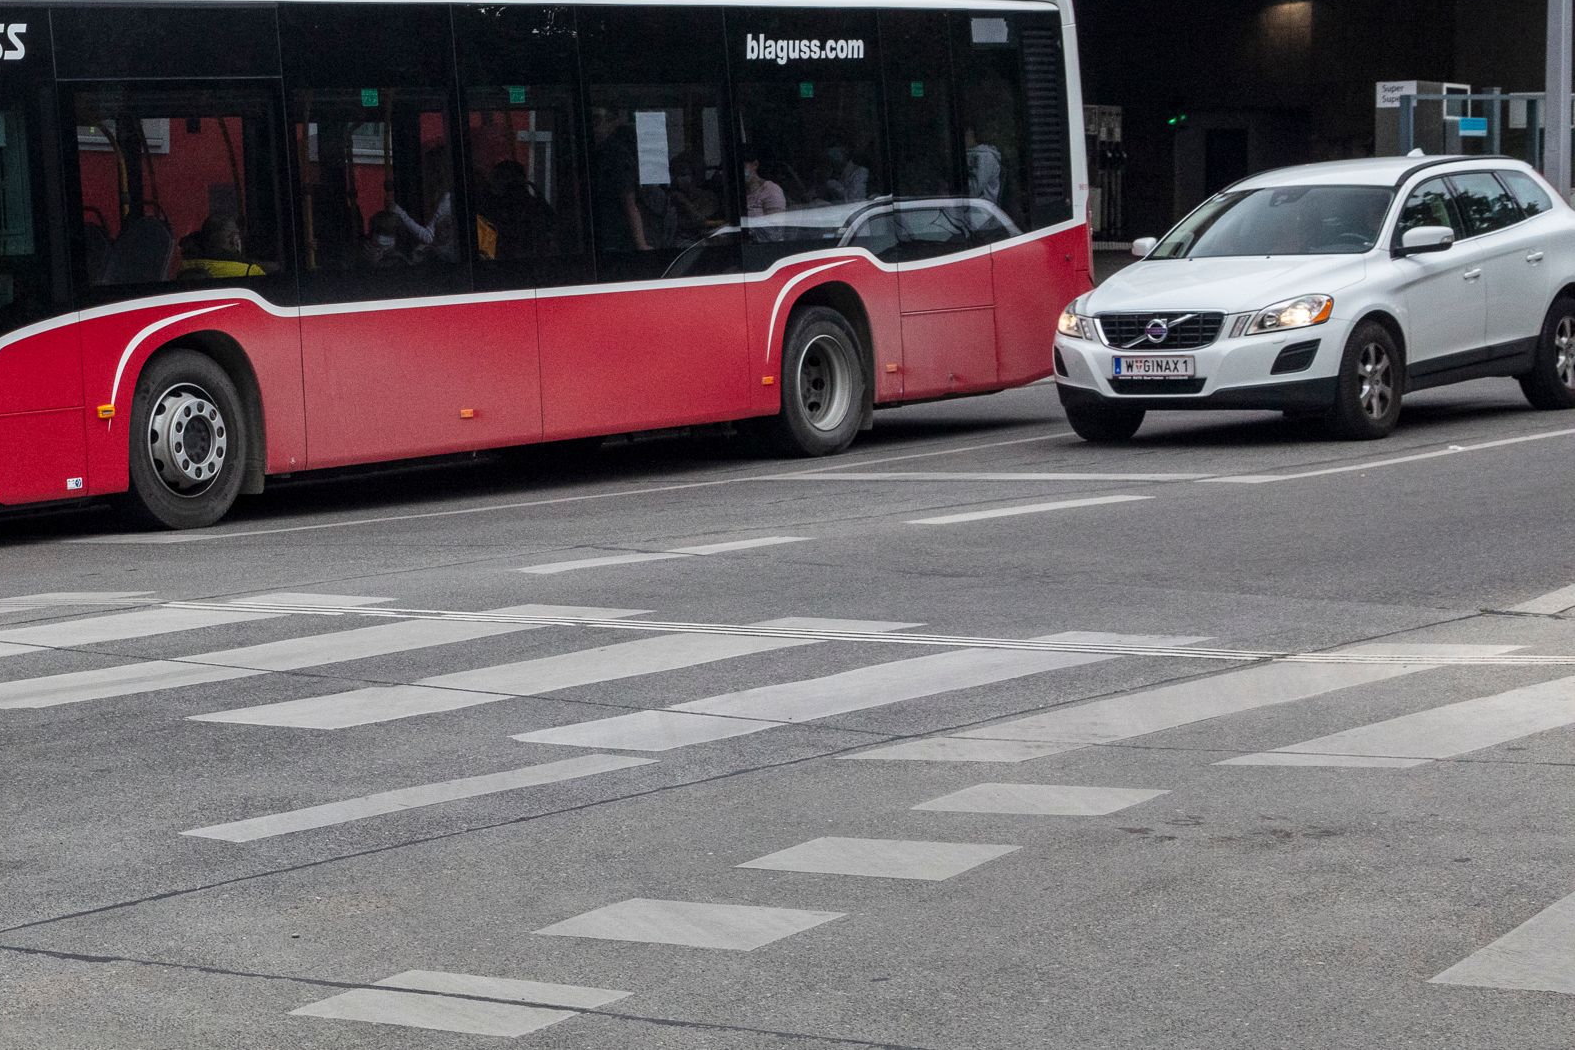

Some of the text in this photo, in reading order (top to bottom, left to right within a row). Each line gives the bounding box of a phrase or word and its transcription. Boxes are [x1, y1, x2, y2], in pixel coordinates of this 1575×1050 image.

[746, 33, 864, 65] blaguss.com
[1381, 84, 1405, 95] Super
[1125, 359, 1134, 373] W
